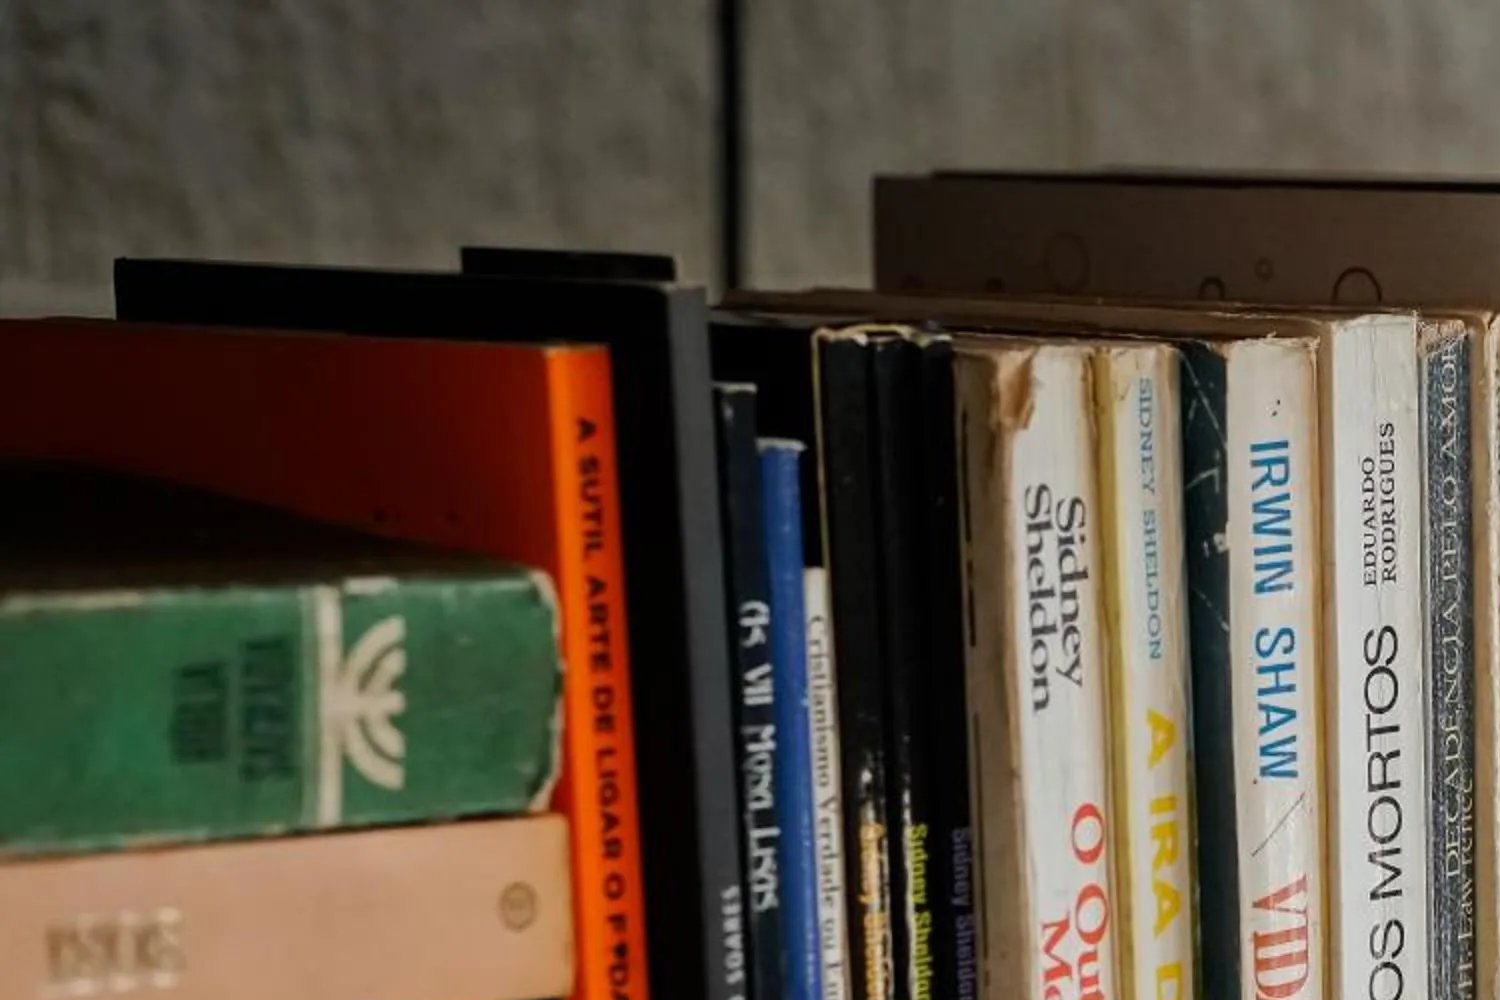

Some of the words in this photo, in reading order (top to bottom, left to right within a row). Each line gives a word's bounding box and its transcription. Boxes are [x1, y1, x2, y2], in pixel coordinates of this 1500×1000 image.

[577, 417, 596, 442] A
[1138, 377, 1156, 495] SIDNEY
[579, 456, 603, 557] SUTIL
[1249, 440, 1295, 597] IRWIN
[1362, 456, 1377, 587] EDUARDO
[1379, 422, 1397, 585] RODRIGUES
[587, 575, 611, 672] ARTE
[1023, 483, 1054, 713] Sheldon
[1056, 495, 1089, 688] Sidney
[1142, 509, 1163, 660] SHELDON
[593, 685, 615, 734] DE
[1146, 709, 1177, 769] A
[1255, 626, 1300, 781] SHAW
[1363, 623, 1404, 901] MORTOS
[603, 872, 625, 900] O
[908, 823, 928, 904] Sidney
[950, 826, 970, 906] Sidney
[1071, 802, 1105, 865] O
[1149, 794, 1184, 939] IRA
